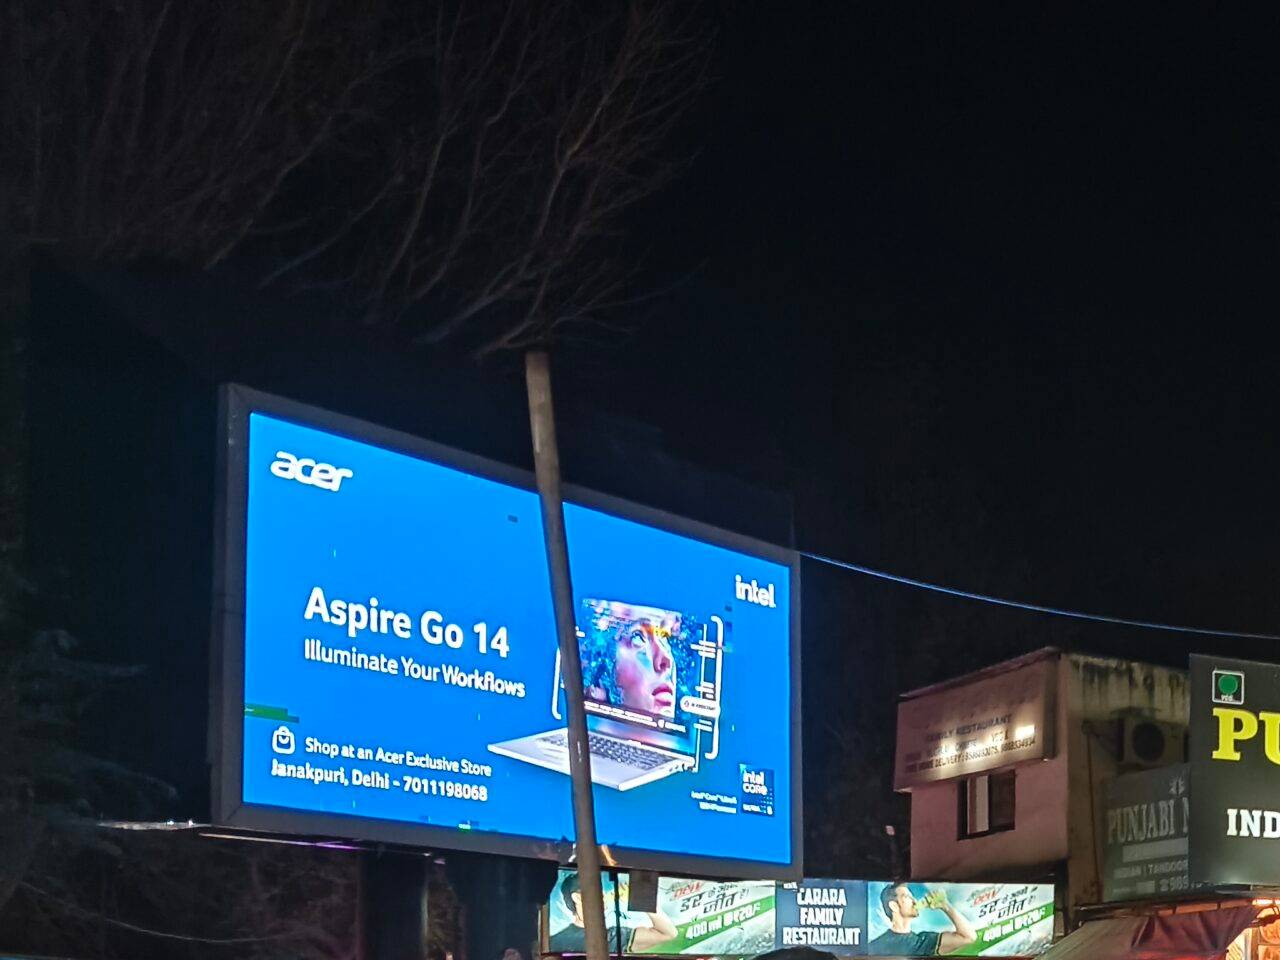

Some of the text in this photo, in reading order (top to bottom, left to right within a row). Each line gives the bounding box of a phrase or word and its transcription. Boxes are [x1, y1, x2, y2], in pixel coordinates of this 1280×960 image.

[270, 451, 354, 492] acer
[736, 574, 776, 608] intel
[304, 586, 510, 658] Aspire Go 14
[304, 638, 526, 698] Illuminate Your Workflows
[305, 736, 492, 777] Shop at an Acer Exclusive Store
[271, 758, 349, 787] Janakpuri,
[351, 768, 390, 790] Delhi
[402, 775, 488, 802] 7011198068
[1106, 799, 1175, 844] PUNJABI
[782, 926, 860, 945] RESTAURANT
[800, 907, 843, 926] FAMILY
